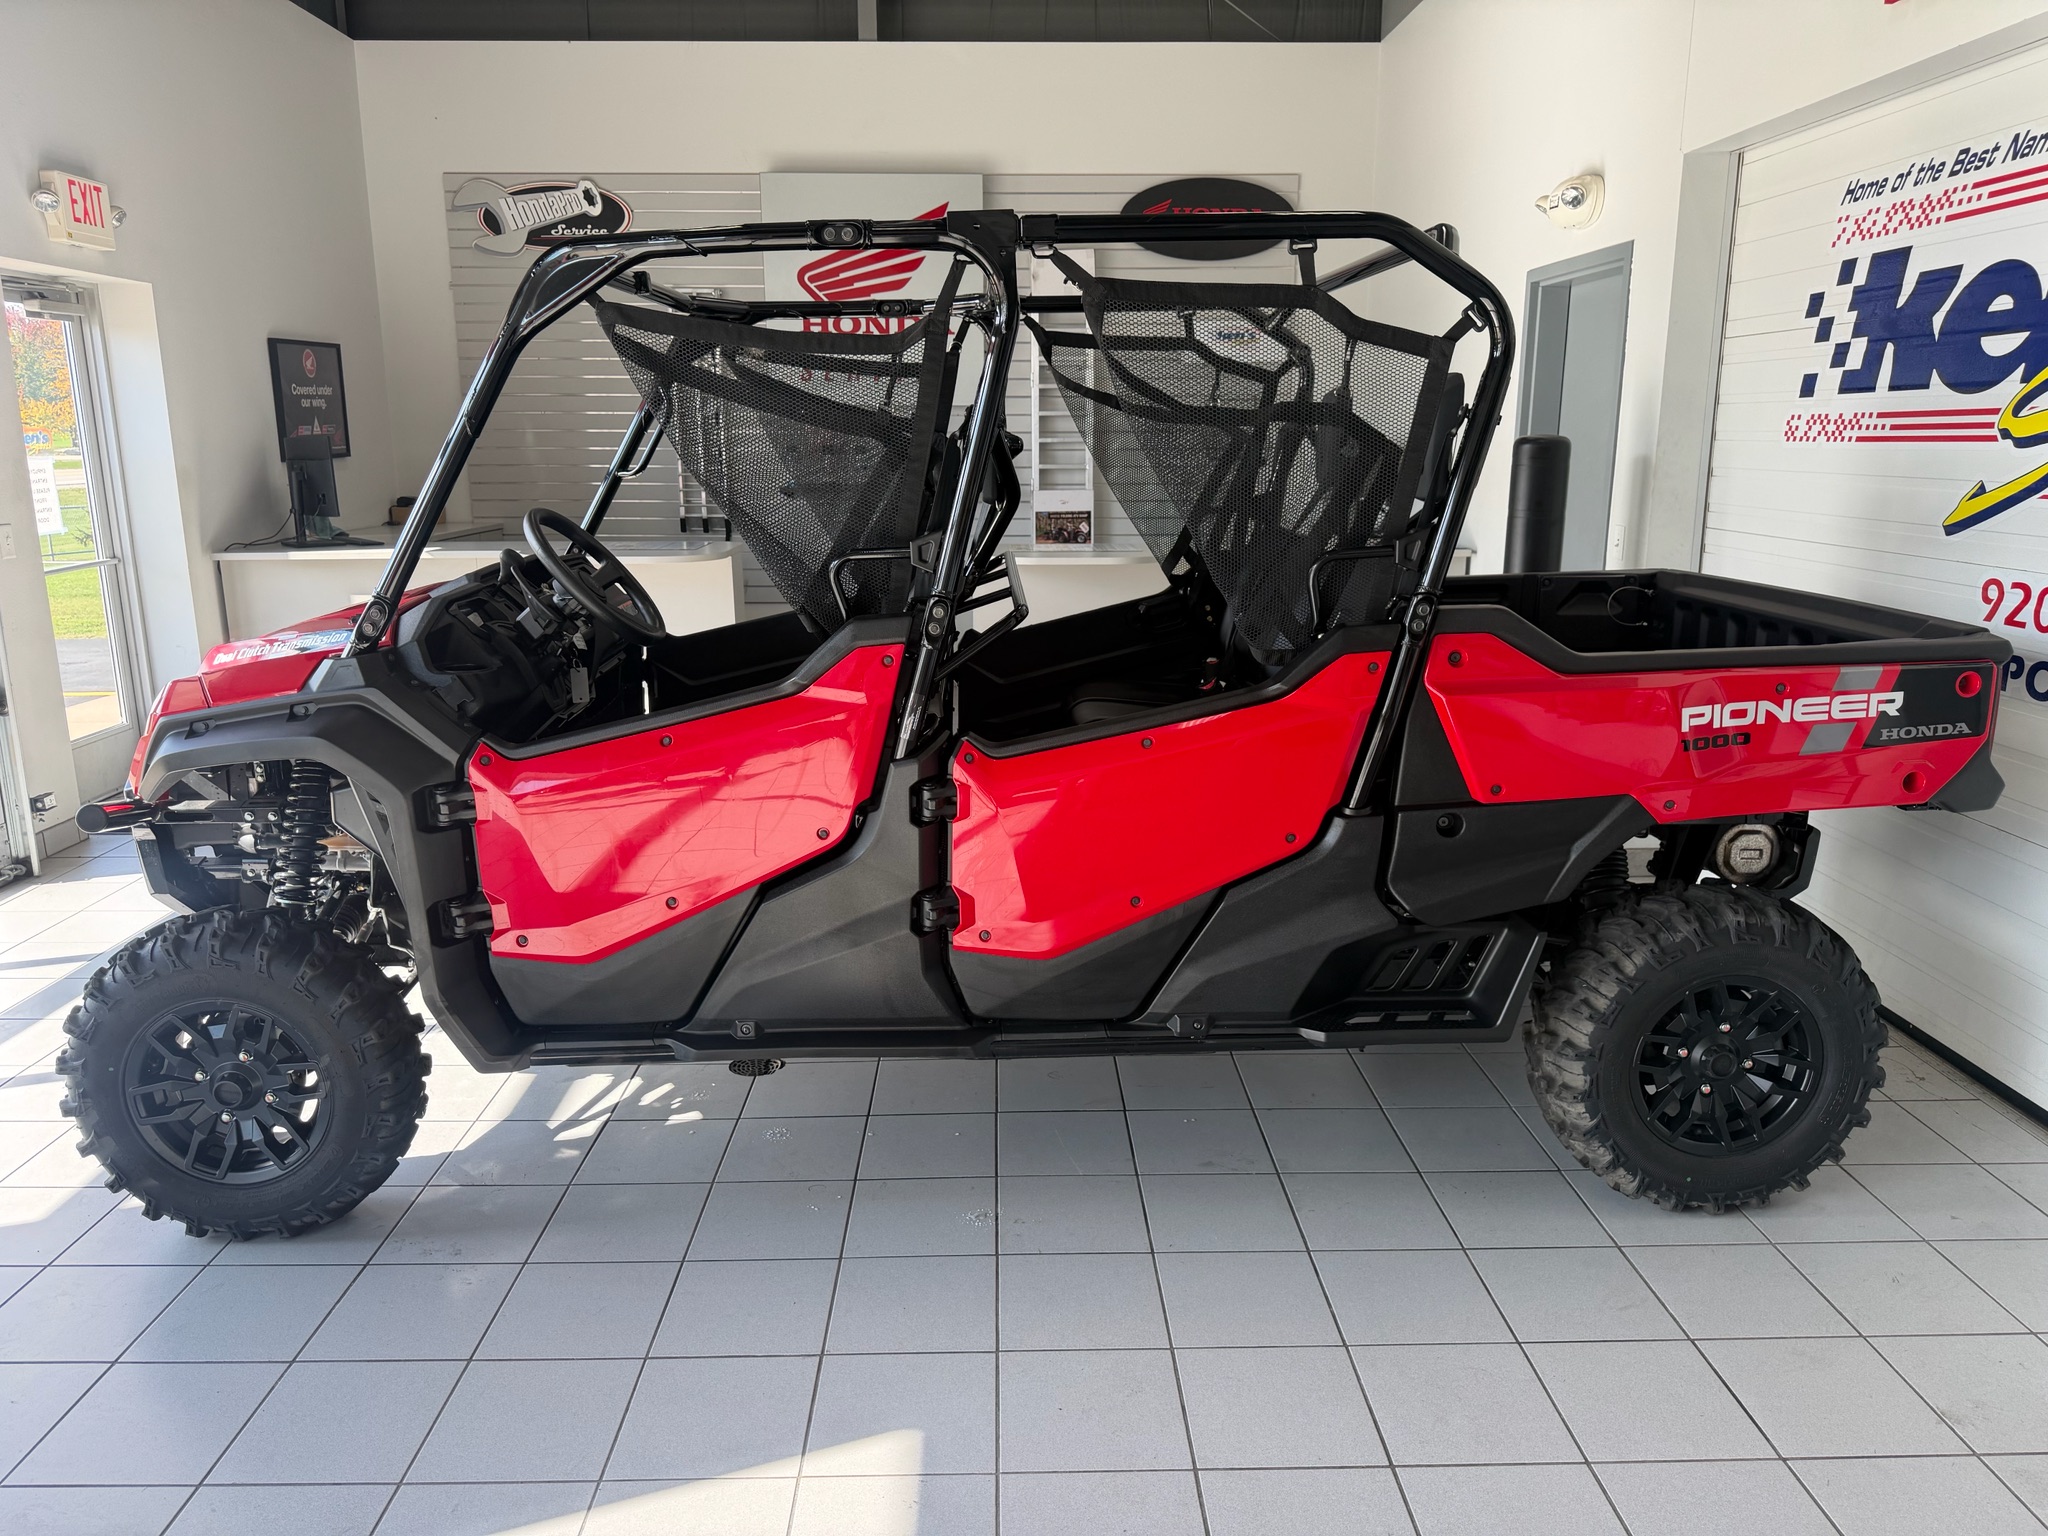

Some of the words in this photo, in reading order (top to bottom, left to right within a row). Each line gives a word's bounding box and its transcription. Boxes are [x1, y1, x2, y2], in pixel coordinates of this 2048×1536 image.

[1840, 176, 1889, 206] Home
[1890, 163, 1916, 193] of
[1913, 157, 1947, 187] the
[1947, 142, 2002, 178] Best
[67, 178, 105, 229] EXIT
[498, 191, 583, 231] HondaPro
[551, 224, 609, 236] Service
[1837, 245, 2048, 394] ke
[291, 383, 316, 395] Covered
[317, 384, 333, 396] under
[301, 397, 311, 407] our
[312, 396, 327, 409] wing.
[213, 650, 237, 665] Dual
[237, 644, 272, 660] Clutch
[271, 632, 348, 654] Transmission
[1681, 691, 1905, 732] PIONEER
[1681, 731, 1751, 753] 1000
[1879, 722, 1973, 741] HONDA
